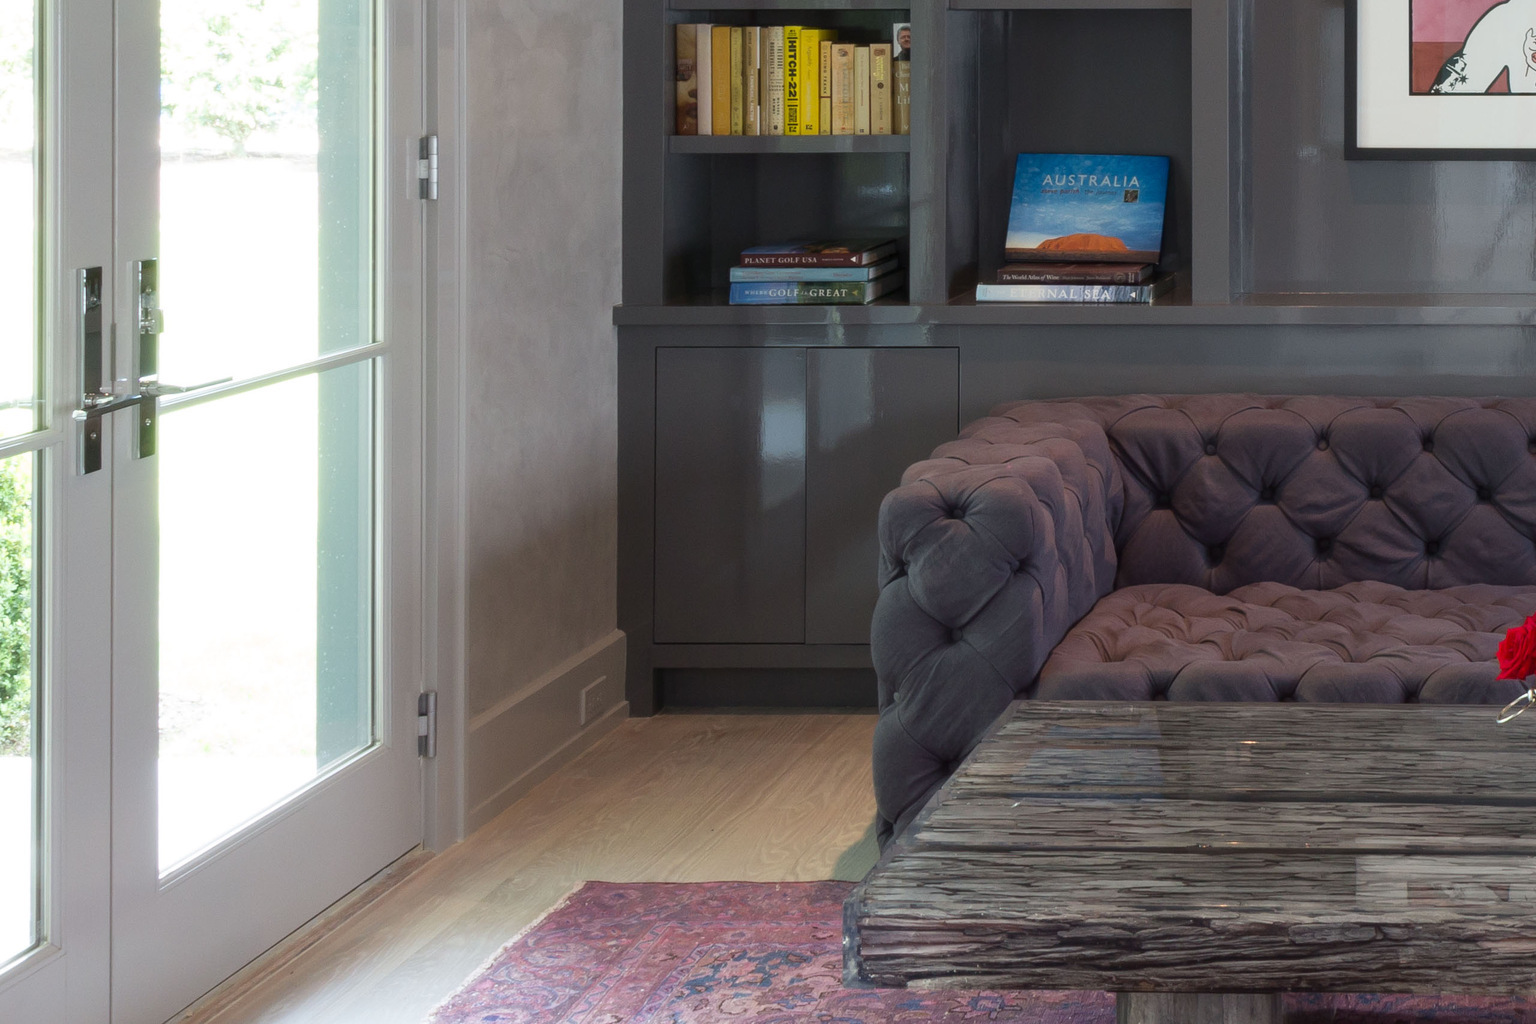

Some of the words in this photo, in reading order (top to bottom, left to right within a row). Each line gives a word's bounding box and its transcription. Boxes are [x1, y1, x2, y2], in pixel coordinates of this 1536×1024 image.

[788, 39, 797, 98] HITCH-22
[1041, 174, 1140, 188] AUSTRALIA
[1084, 188, 1093, 196] the
[744, 256, 775, 265] PLANET
[777, 256, 801, 264] GOLF
[802, 256, 817, 264] USA
[1011, 274, 1027, 282] World
[1039, 274, 1046, 283] of
[744, 289, 768, 297] WHERE
[768, 287, 799, 298] GOLF
[809, 287, 848, 298] GREAT
[1009, 290, 1077, 299] ETERNAL
[1084, 290, 1112, 301] SEA
